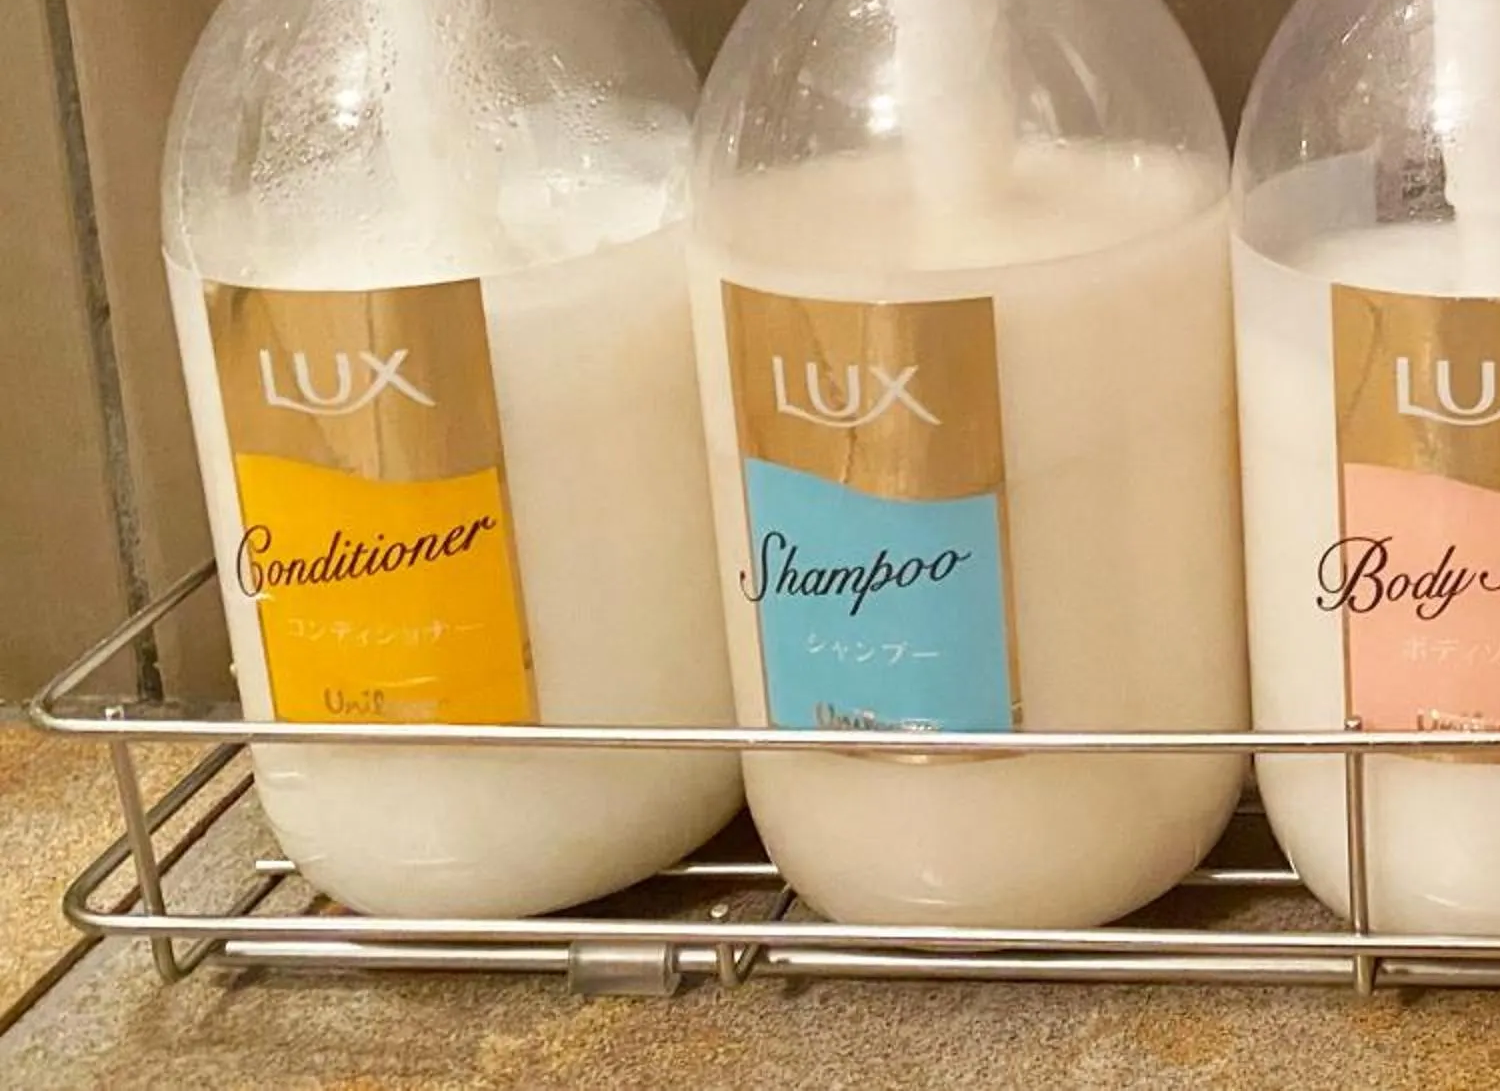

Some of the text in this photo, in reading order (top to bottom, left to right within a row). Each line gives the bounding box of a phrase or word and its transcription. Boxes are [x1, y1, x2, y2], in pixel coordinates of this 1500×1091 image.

[260, 348, 435, 416] LUX
[772, 355, 941, 427] LUX
[236, 514, 496, 597] Conditioner
[740, 532, 972, 616] Shampoo
[1316, 536, 1478, 620] Body
